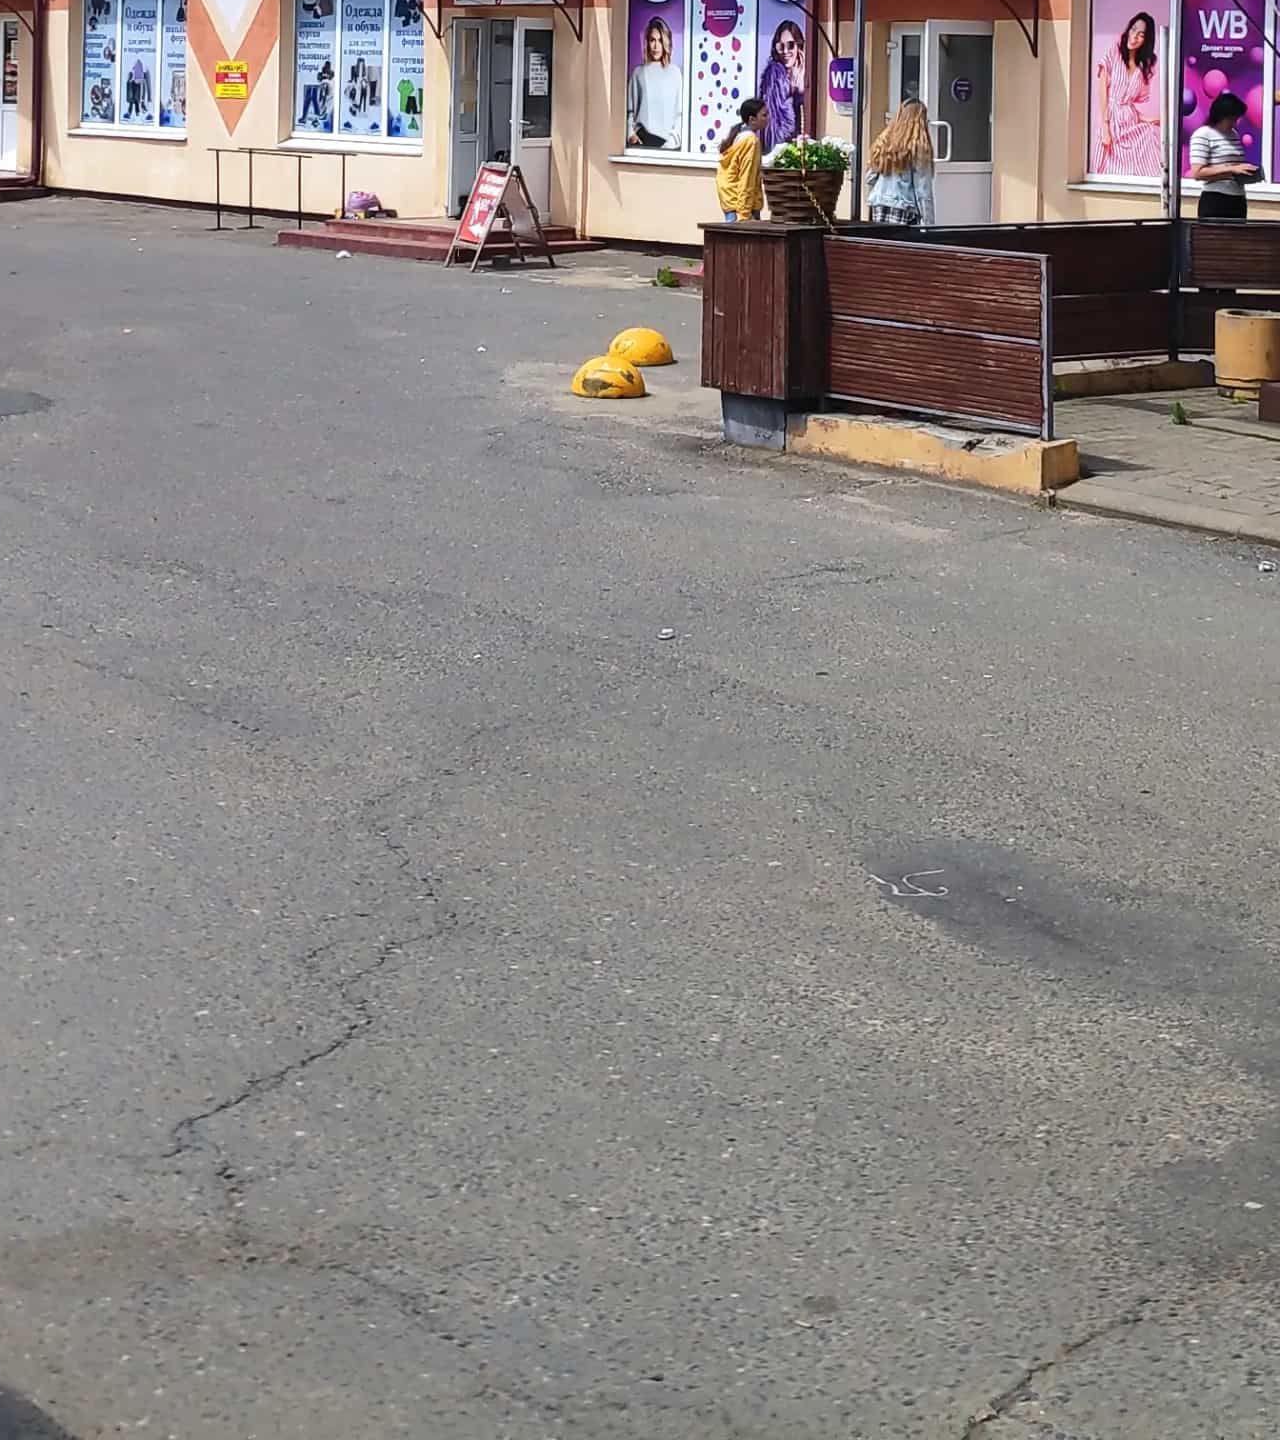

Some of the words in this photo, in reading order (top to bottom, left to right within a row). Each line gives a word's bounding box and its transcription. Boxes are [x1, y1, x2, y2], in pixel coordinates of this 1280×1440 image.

[345, 4, 383, 18] Одежда
[347, 23, 353, 32] и
[355, 20, 381, 35] обувь
[1198, 10, 1248, 39] WB
